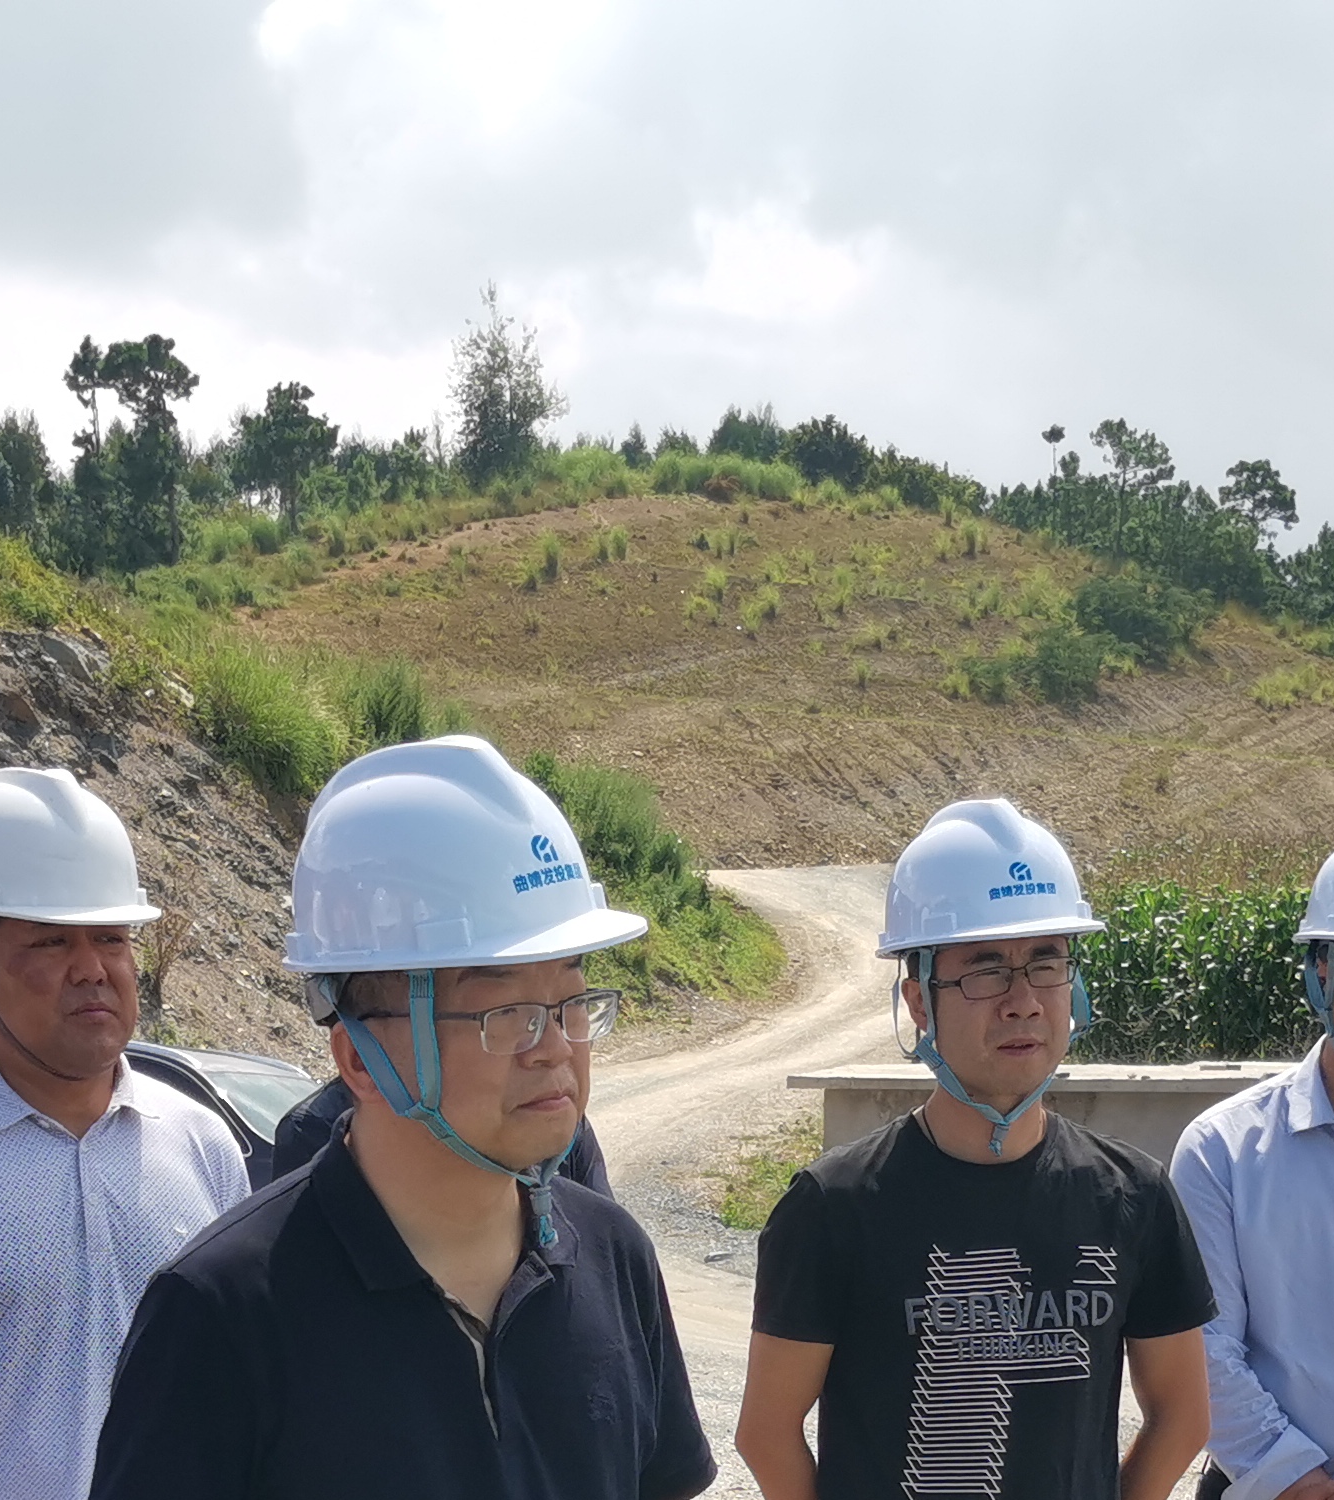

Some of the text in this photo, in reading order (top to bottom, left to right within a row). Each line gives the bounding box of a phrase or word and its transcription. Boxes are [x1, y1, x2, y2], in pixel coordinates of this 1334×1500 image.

[513, 863, 583, 895] 曲靖发投集团
[989, 883, 1056, 900] 曲靖发投集团
[904, 1290, 1114, 1335] FORWARD
[952, 1333, 1080, 1360] THINKING
